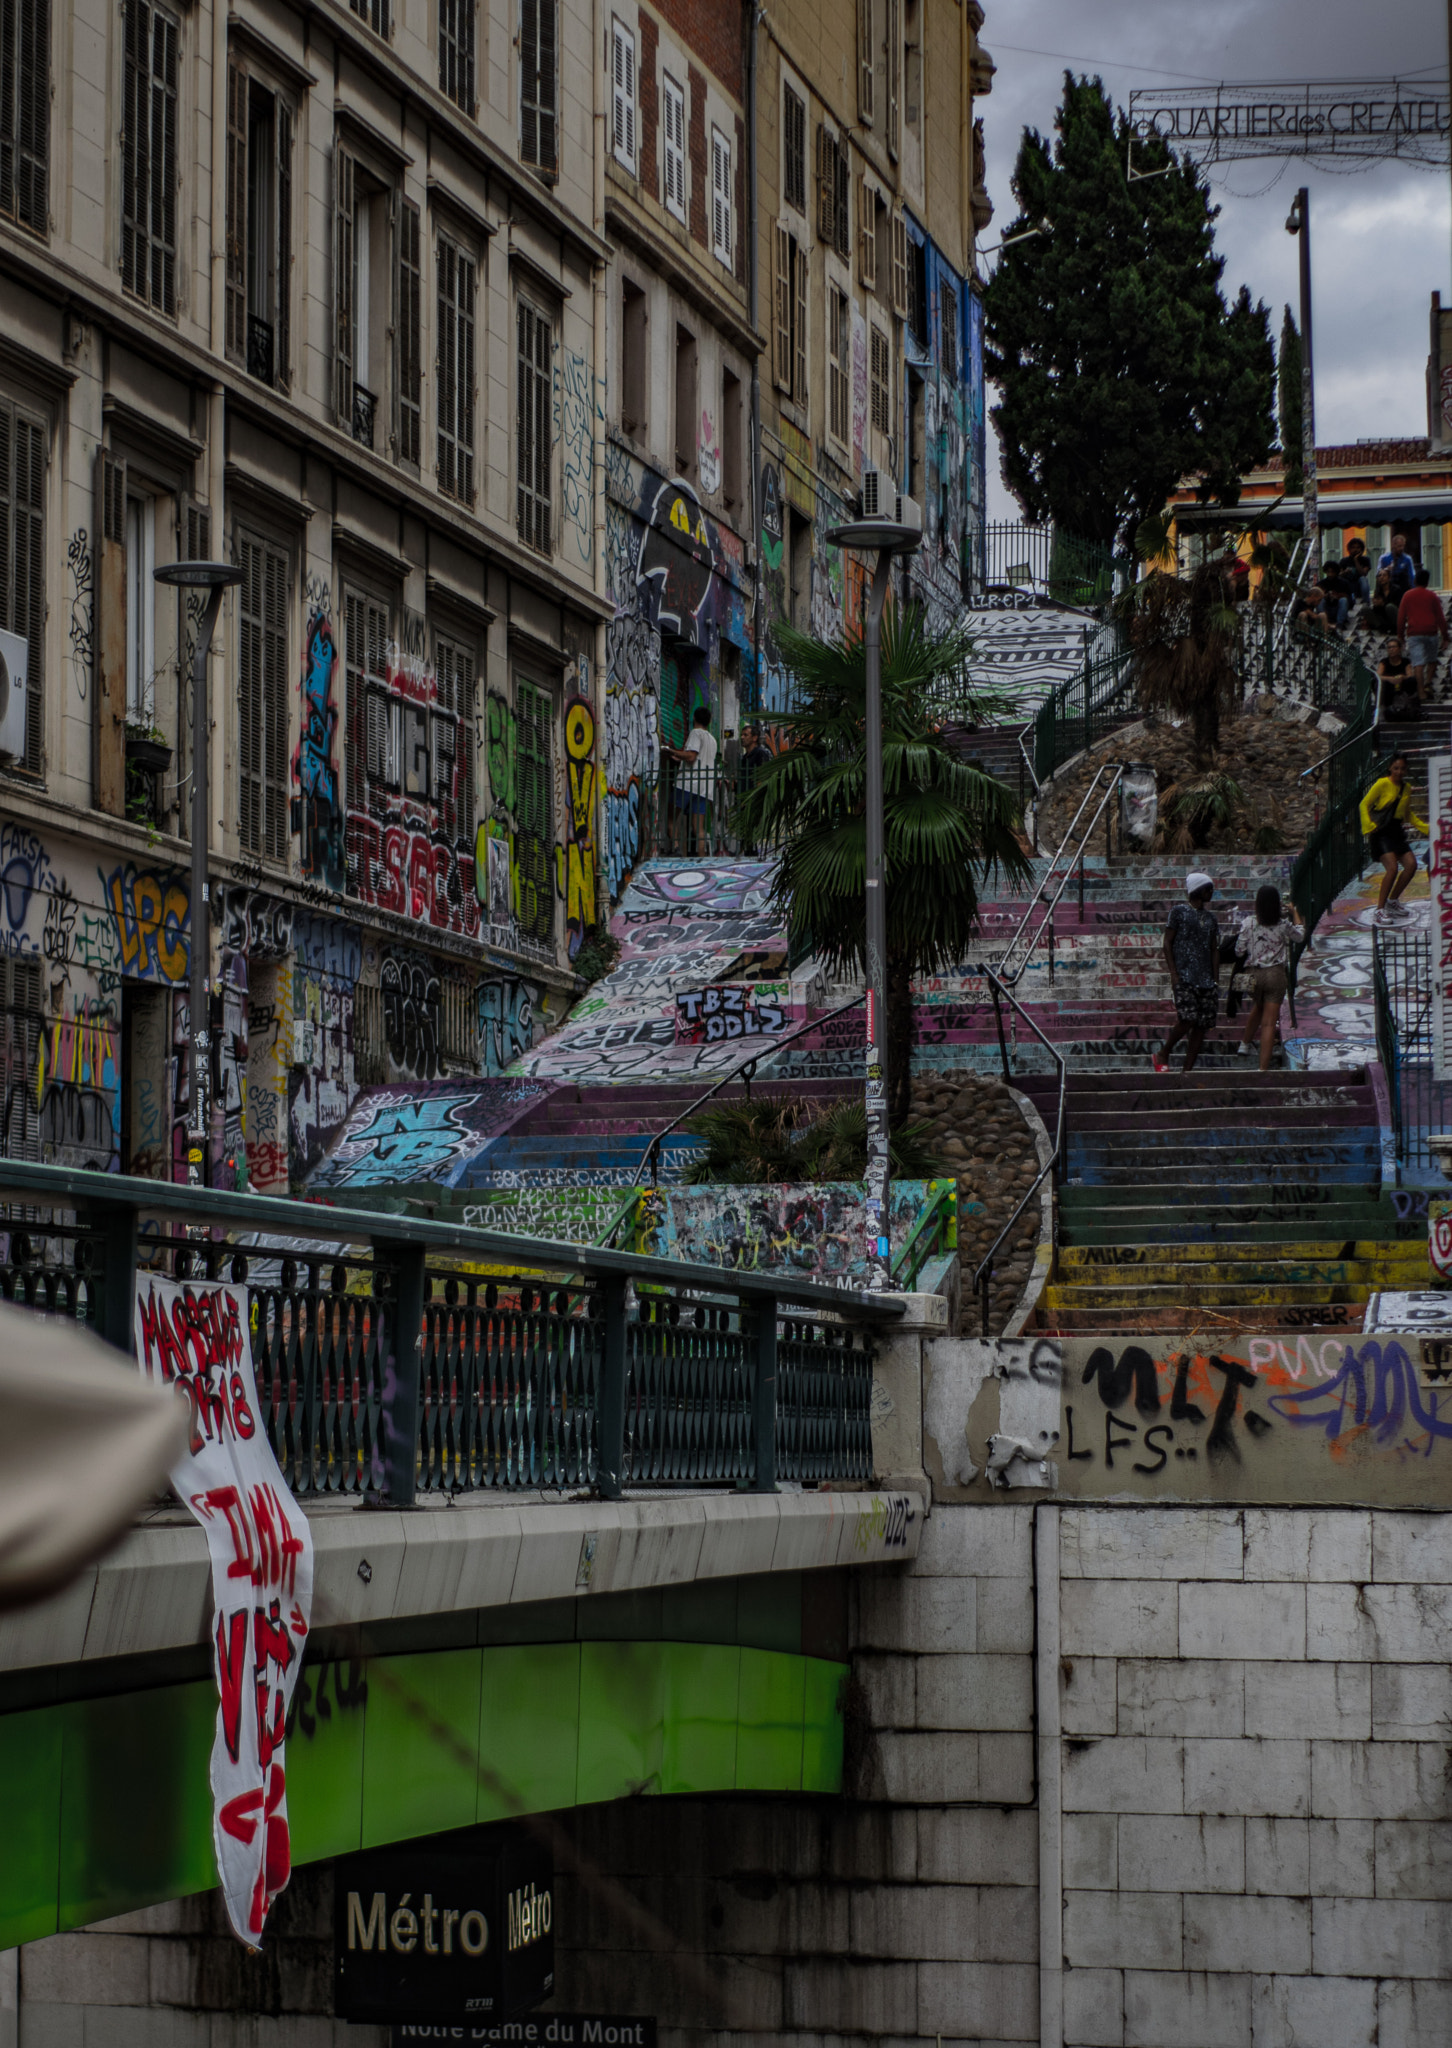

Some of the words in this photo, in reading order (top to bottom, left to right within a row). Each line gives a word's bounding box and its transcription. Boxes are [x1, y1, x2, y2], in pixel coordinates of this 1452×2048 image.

[1153, 104, 1285, 138] QUARTIER
[1286, 104, 1325, 135] des
[14, 675, 22, 688] LG
[676, 987, 745, 1022] TBZ
[347, 1890, 489, 1956] Métro
[508, 1881, 552, 1952] Métro
[471, 2022, 538, 2041] Dame
[545, 2018, 574, 2042] du
[582, 2019, 644, 2046] Mont
